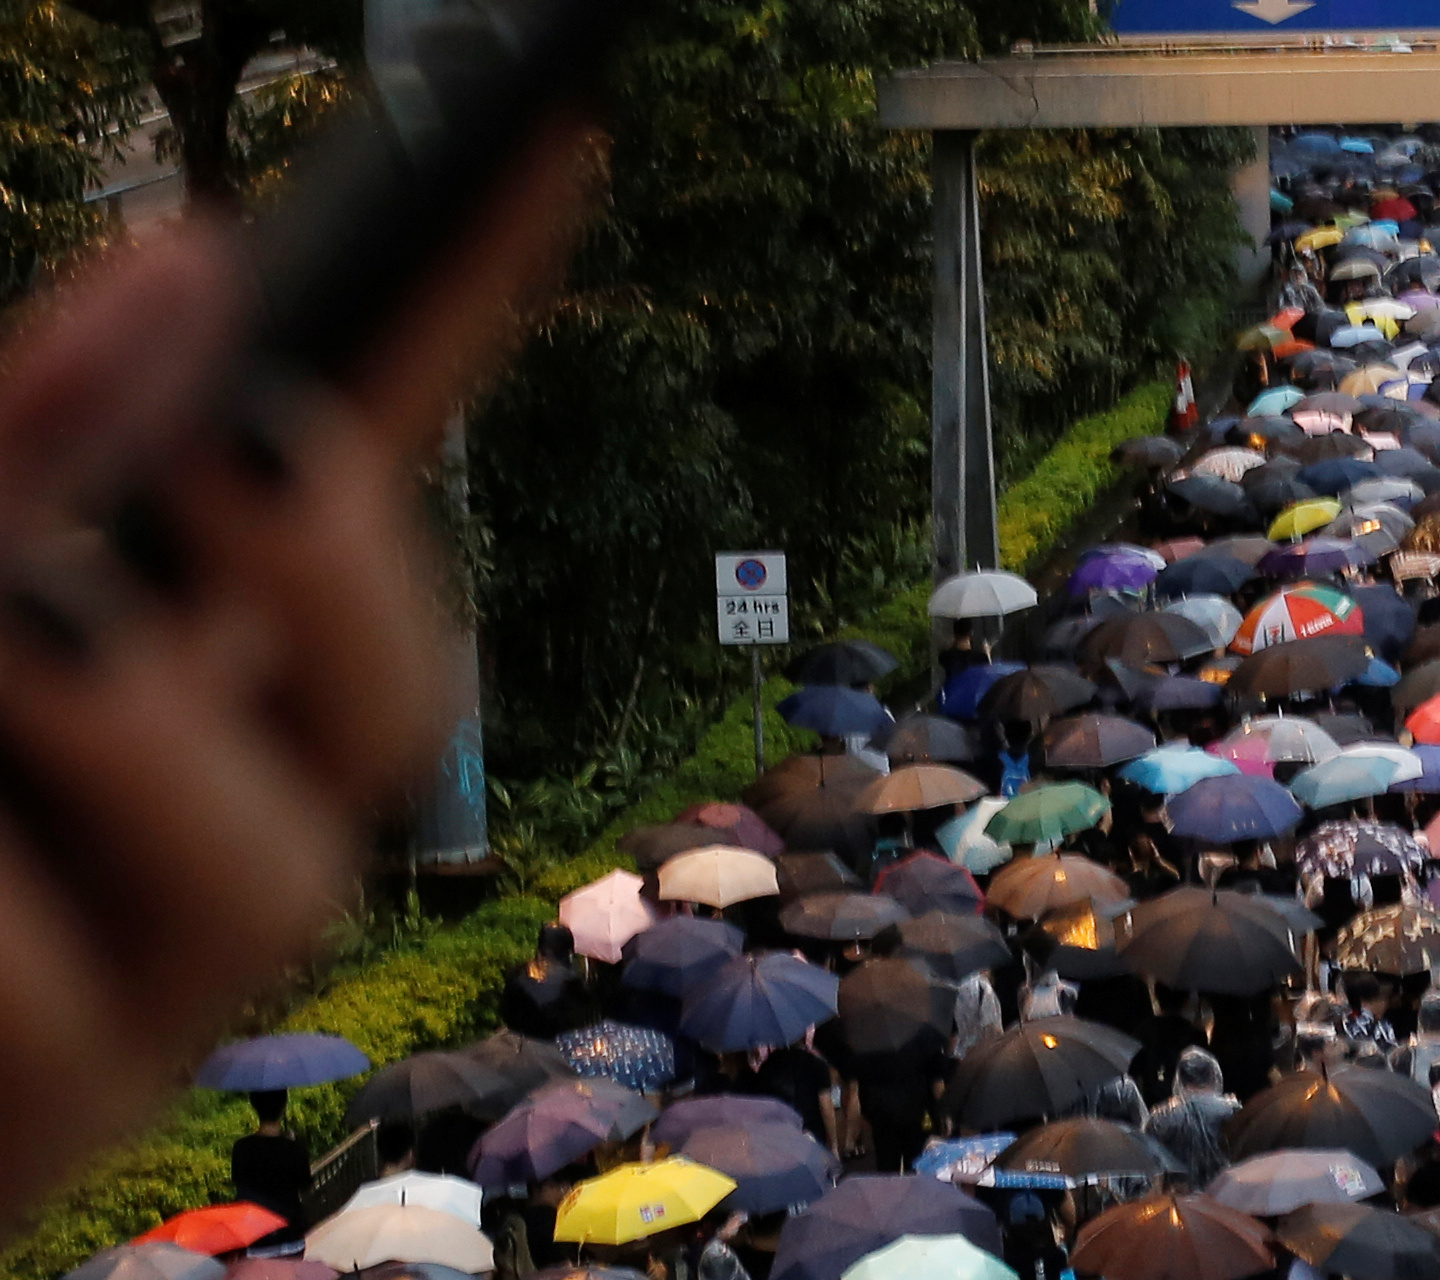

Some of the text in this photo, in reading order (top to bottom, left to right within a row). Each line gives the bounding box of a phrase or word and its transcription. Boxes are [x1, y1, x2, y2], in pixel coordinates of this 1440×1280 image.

[726, 599, 780, 615] 24 hrs
[732, 617, 774, 639] 全日
